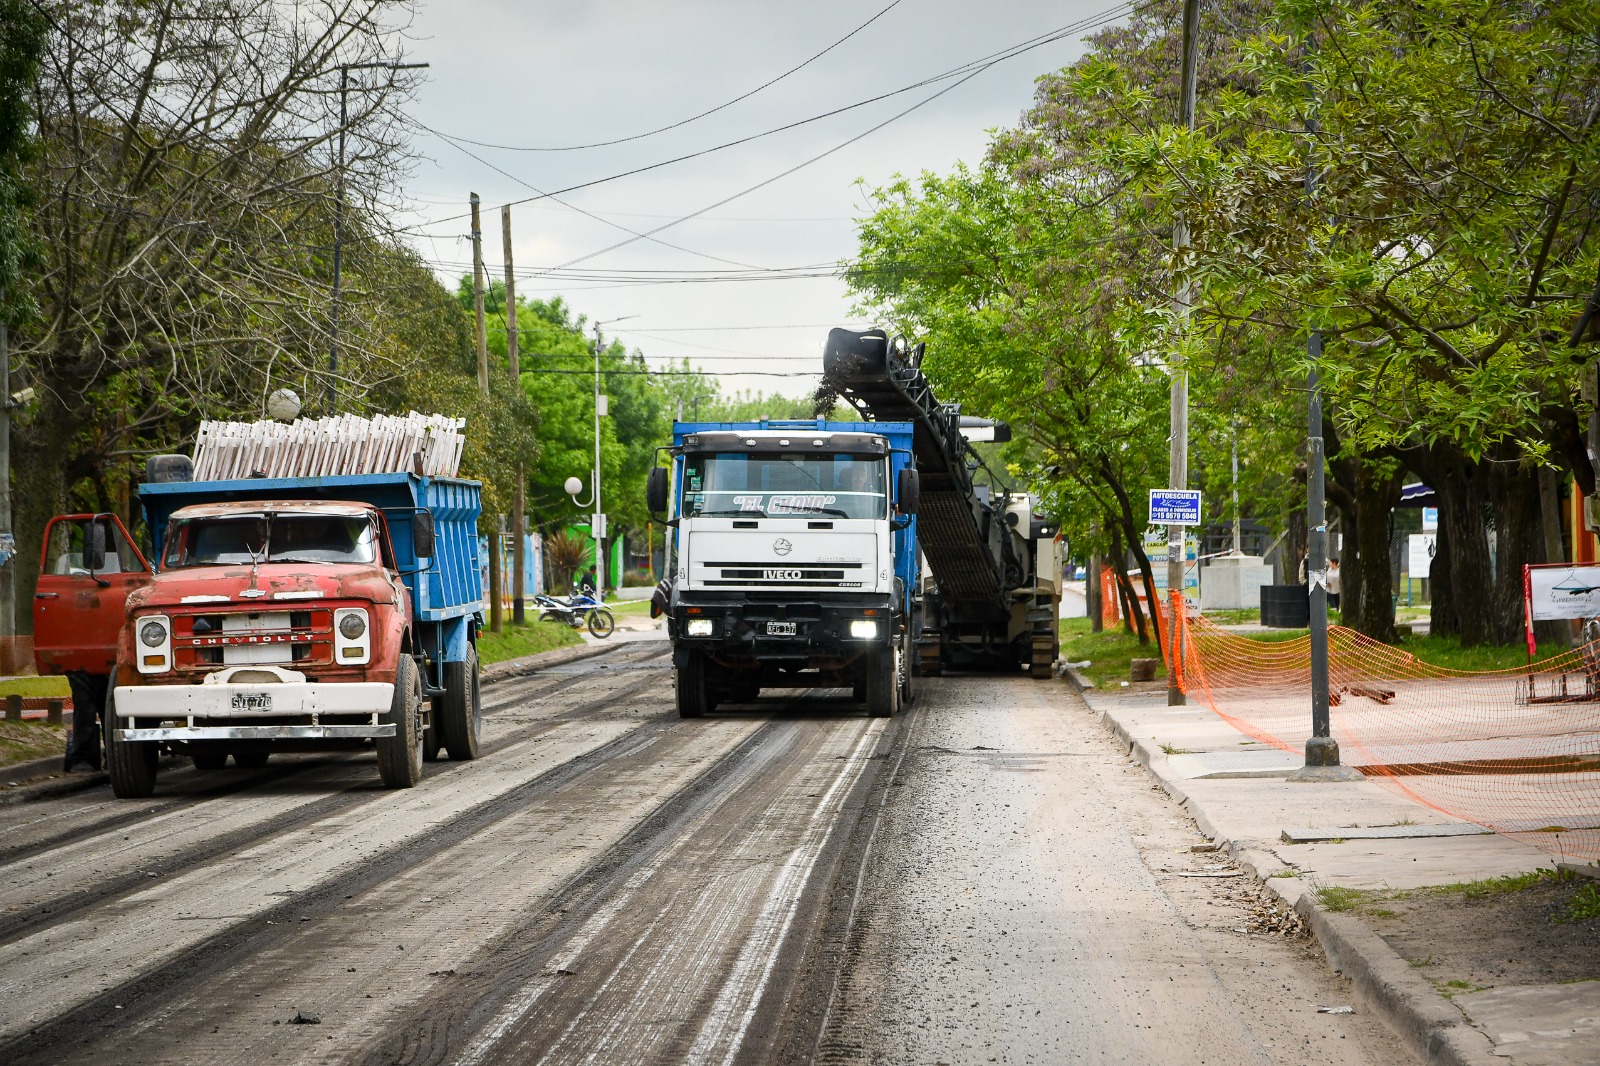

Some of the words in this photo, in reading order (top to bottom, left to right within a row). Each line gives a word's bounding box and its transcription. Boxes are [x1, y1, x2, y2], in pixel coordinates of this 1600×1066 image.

[1152, 492, 1198, 500] AUTOESCUELA
[763, 570, 802, 579] IVECO
[880, 569, 888, 581] 4
[192, 634, 314, 645] CHEVROLET
